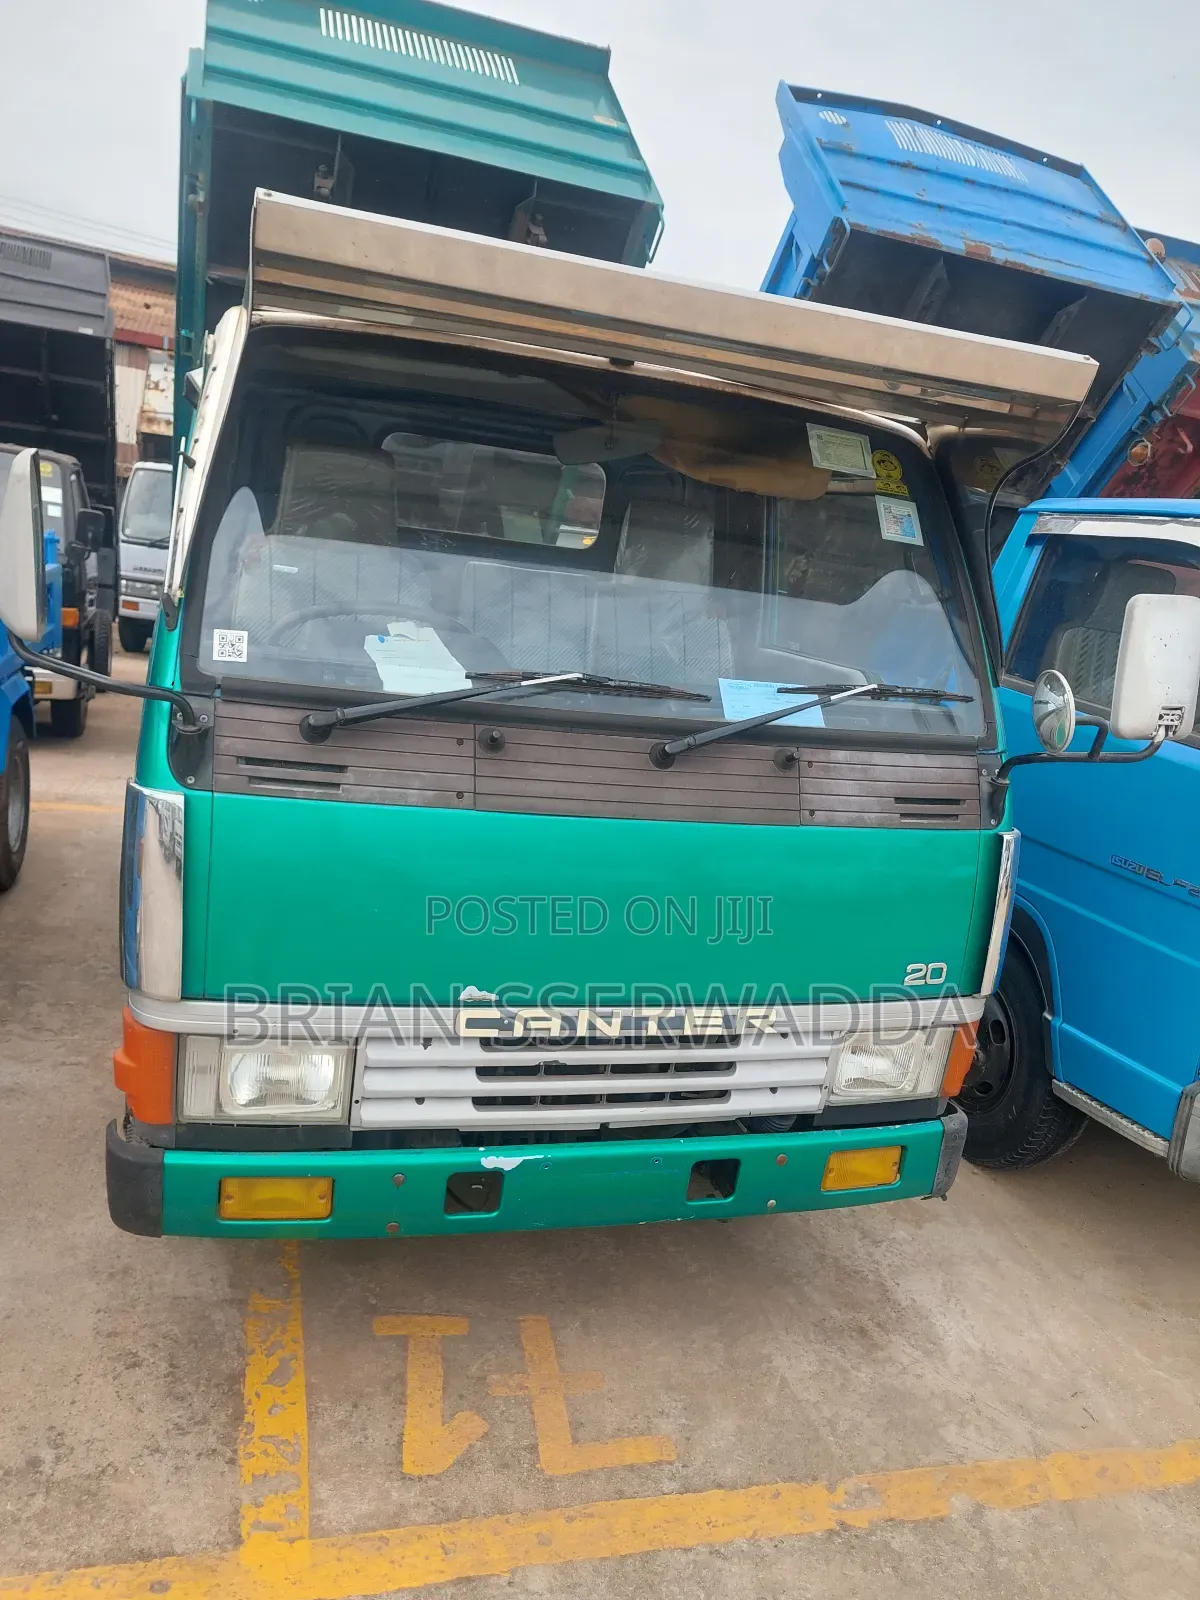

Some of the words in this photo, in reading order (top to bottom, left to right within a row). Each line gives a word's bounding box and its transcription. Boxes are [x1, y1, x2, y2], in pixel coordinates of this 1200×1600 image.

[1111, 854, 1145, 876] ISUZU
[903, 962, 948, 987] 20
[454, 1007, 780, 1038] CANTER
